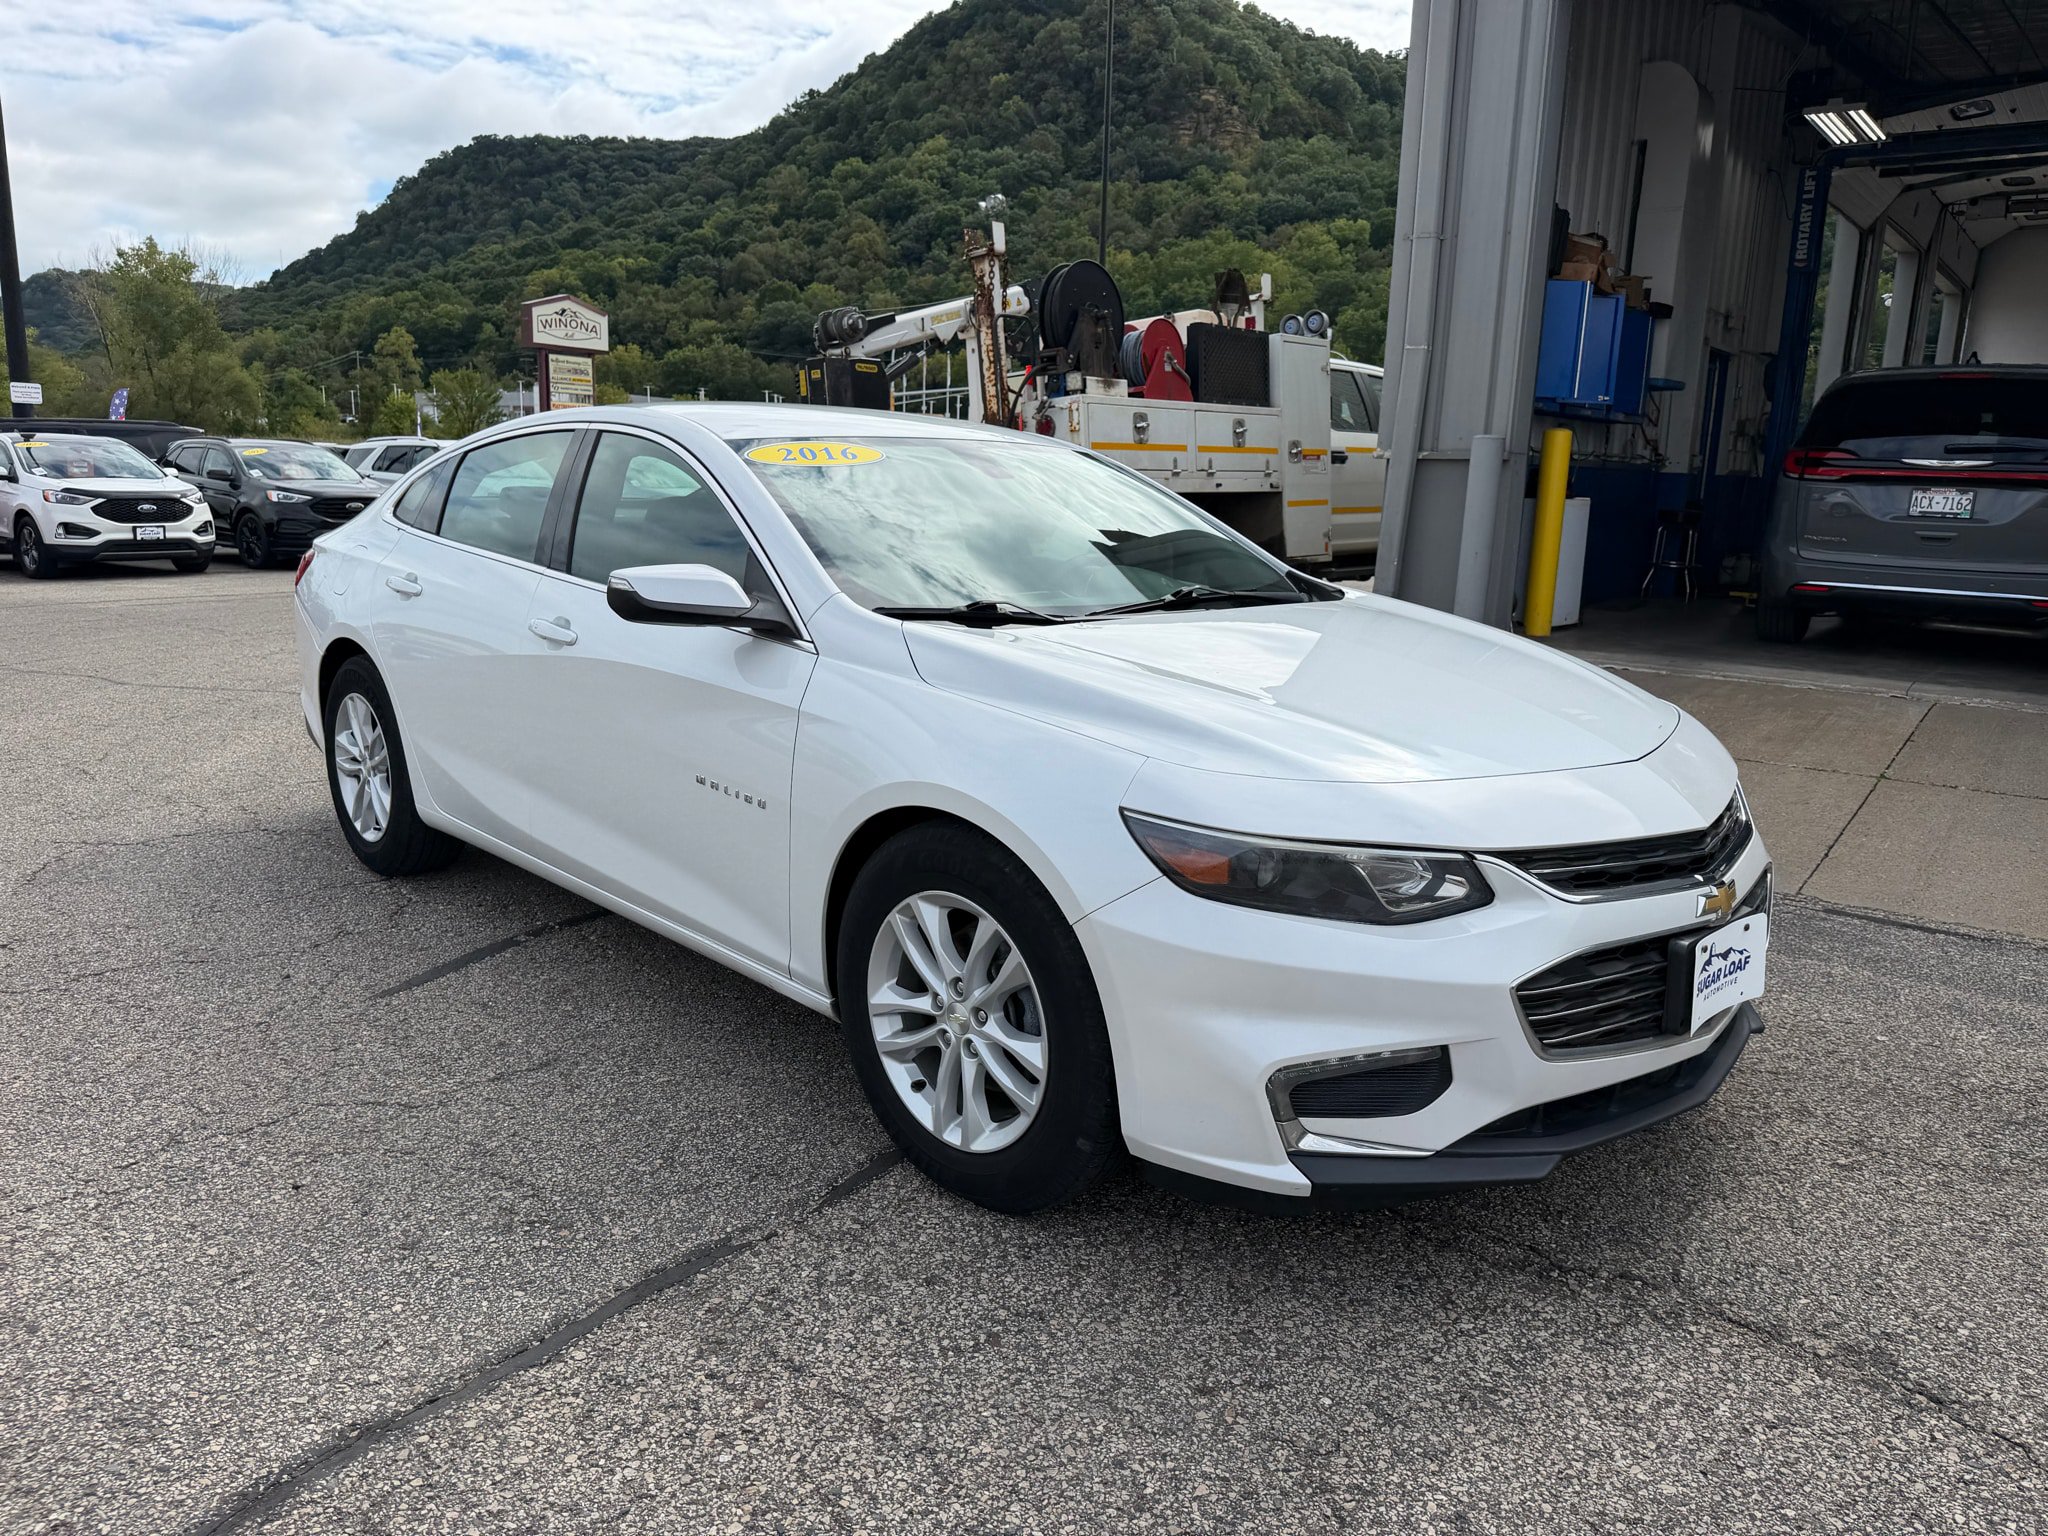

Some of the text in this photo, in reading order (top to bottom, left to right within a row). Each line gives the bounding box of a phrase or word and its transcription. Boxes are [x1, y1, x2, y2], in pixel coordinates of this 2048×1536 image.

[1795, 169, 1817, 260] ROTARY LIFT
[540, 318, 599, 336] WINONA
[777, 447, 858, 461] 2016
[1912, 496, 1972, 511] ACX-7162
[696, 774, 767, 809] MALIBU
[1696, 955, 1751, 998] SUGAR LOAF
[1703, 977, 1738, 1000] AUTOMOTIVE
